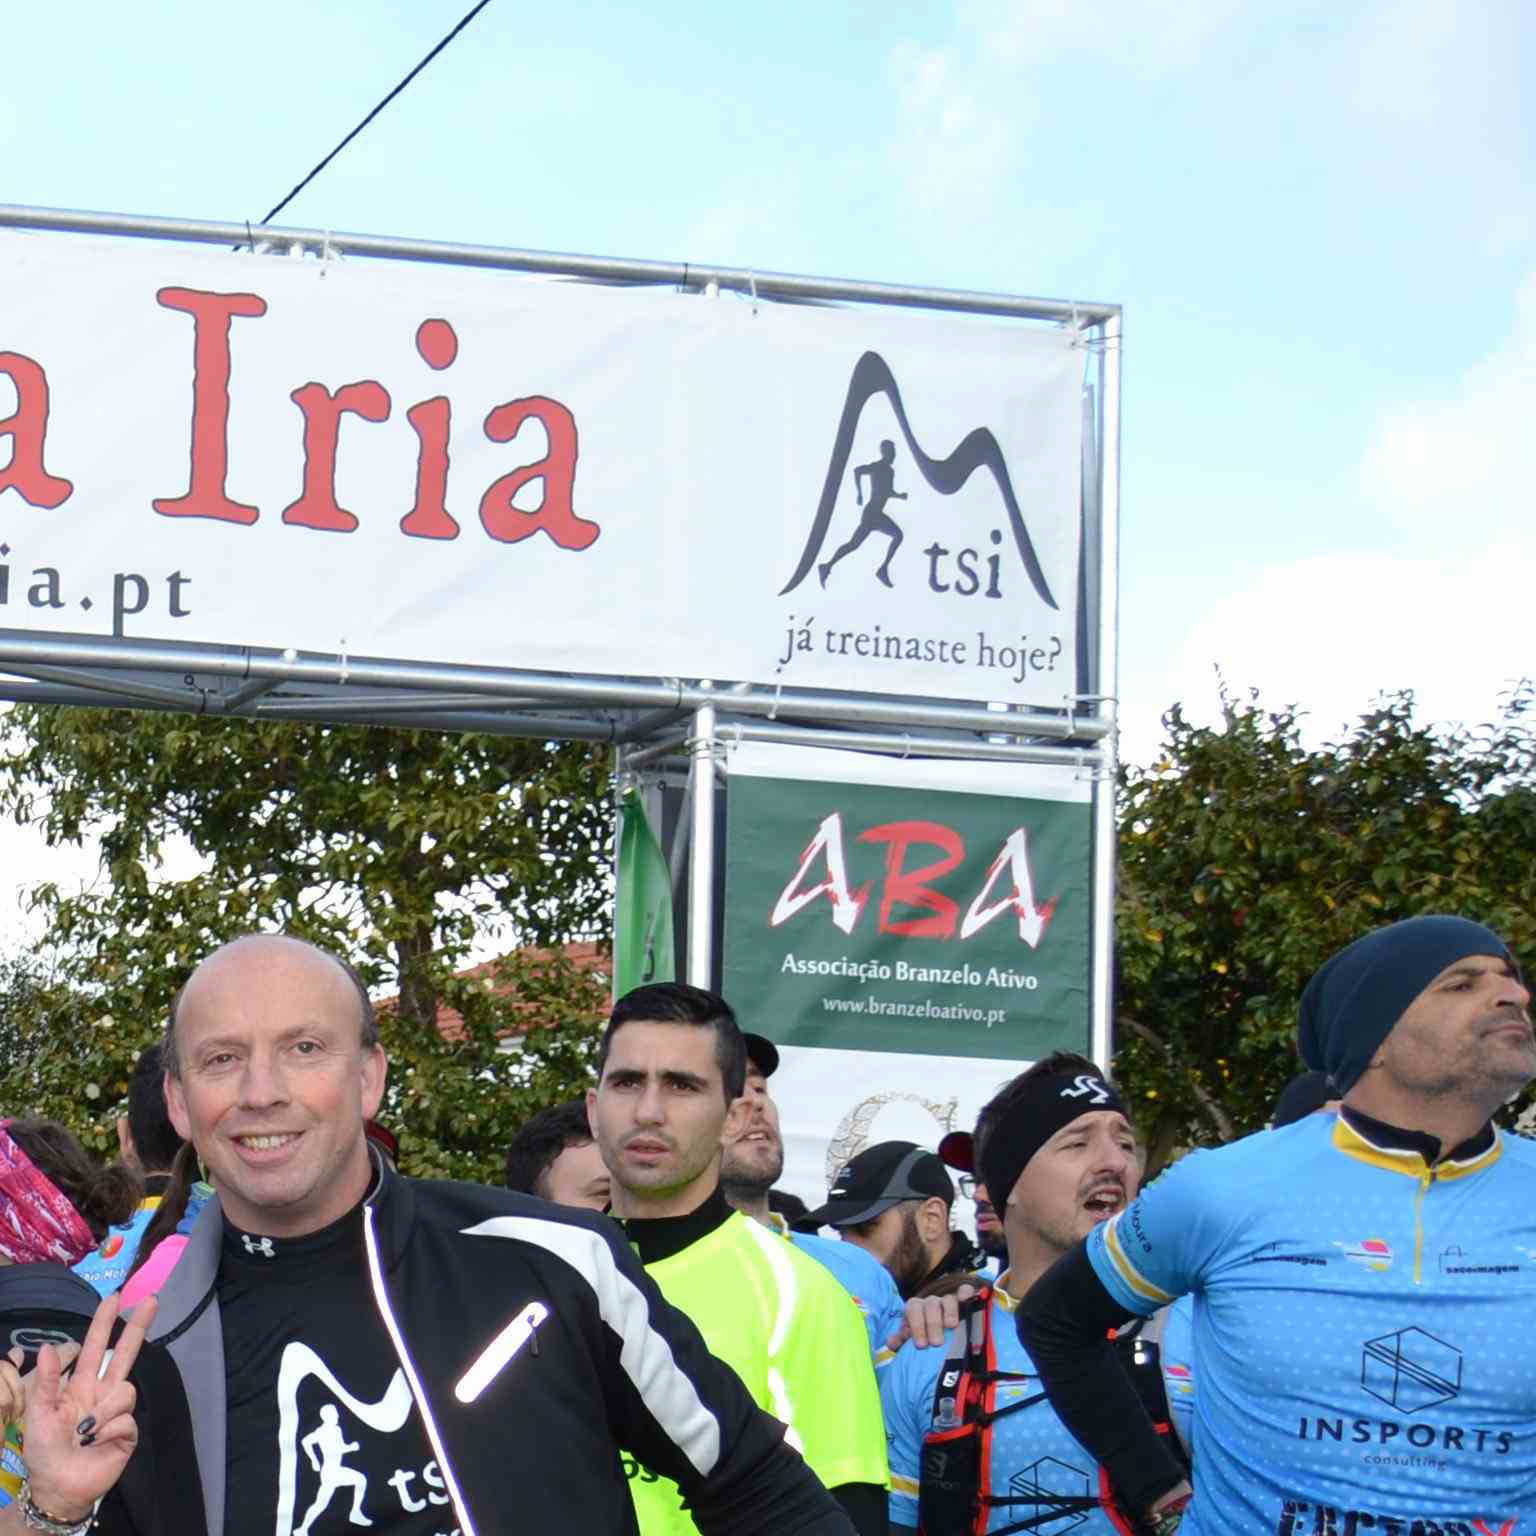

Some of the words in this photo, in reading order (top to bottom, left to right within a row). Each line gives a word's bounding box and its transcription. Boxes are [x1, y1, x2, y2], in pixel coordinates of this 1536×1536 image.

[151, 285, 602, 552] Iria
[924, 529, 1003, 600] tsi
[779, 616, 815, 665] já
[825, 624, 967, 667] treinaste
[976, 633, 1062, 684] hoje?
[770, 811, 1059, 951] ABA
[781, 953, 891, 983] Associação
[895, 961, 982, 987] Branzelo
[985, 967, 1039, 991] Ativo
[823, 995, 1007, 1026] www.branzeloativo.pt
[1299, 1417, 1513, 1455] INSPORTS
[1363, 1455, 1448, 1471] consulting
[387, 1459, 453, 1513] ts
